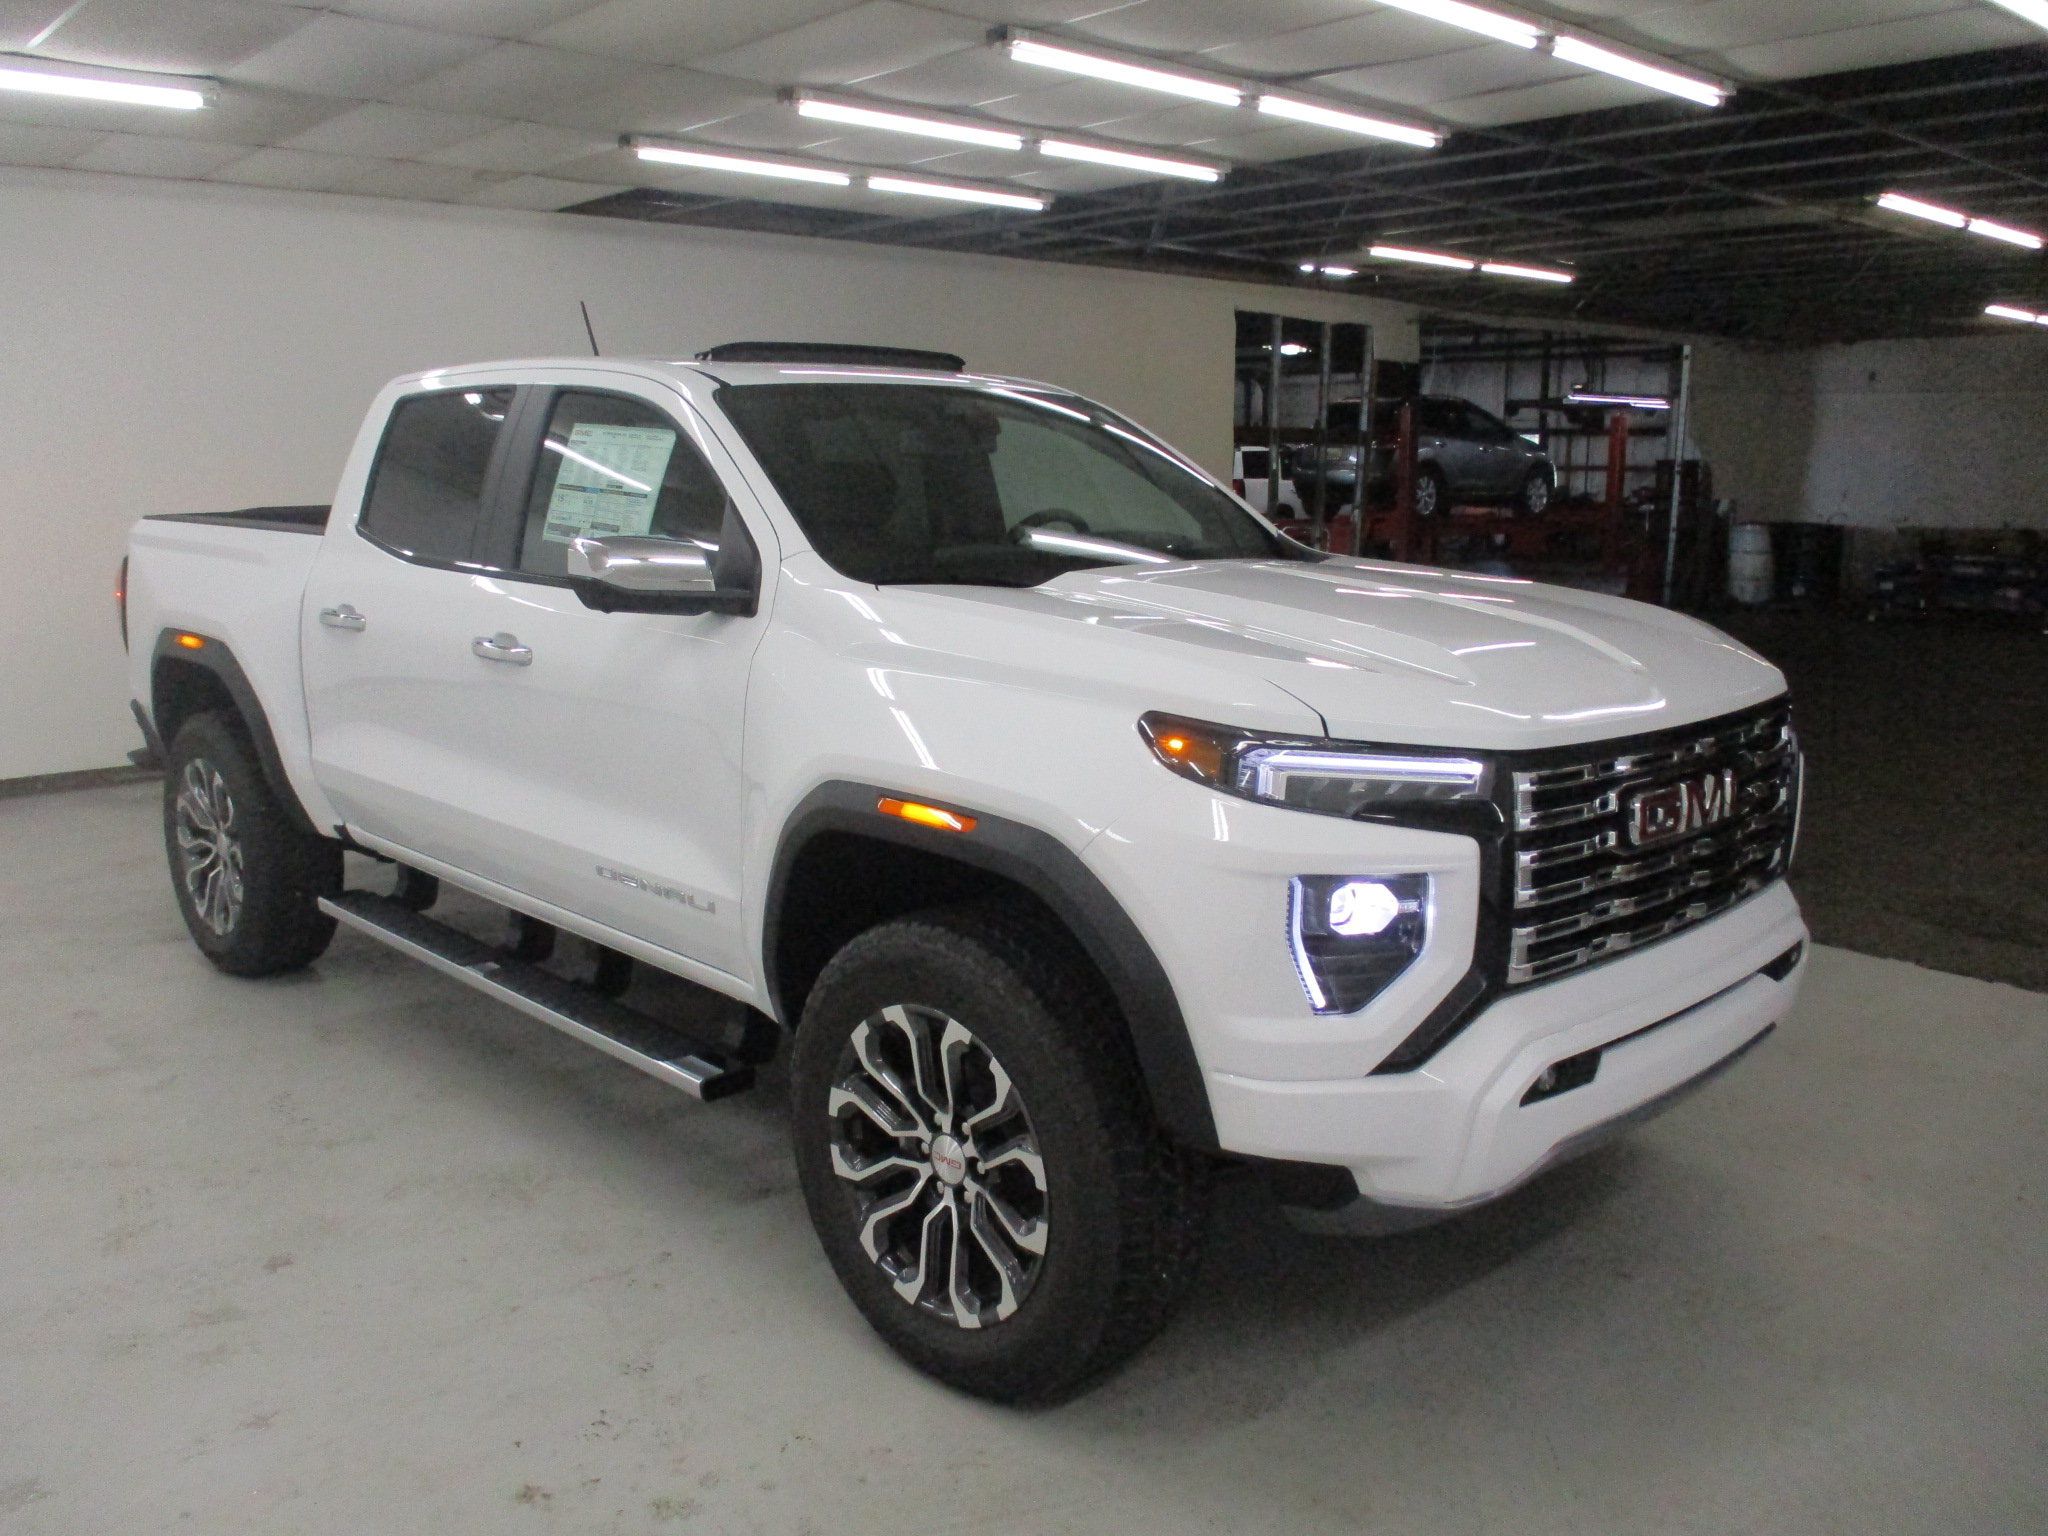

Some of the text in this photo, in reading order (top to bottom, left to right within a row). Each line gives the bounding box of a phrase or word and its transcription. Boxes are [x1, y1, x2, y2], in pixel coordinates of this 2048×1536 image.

[1628, 768, 1737, 846] GM
[595, 864, 716, 914] DENALI
[932, 1151, 962, 1170] GMC
